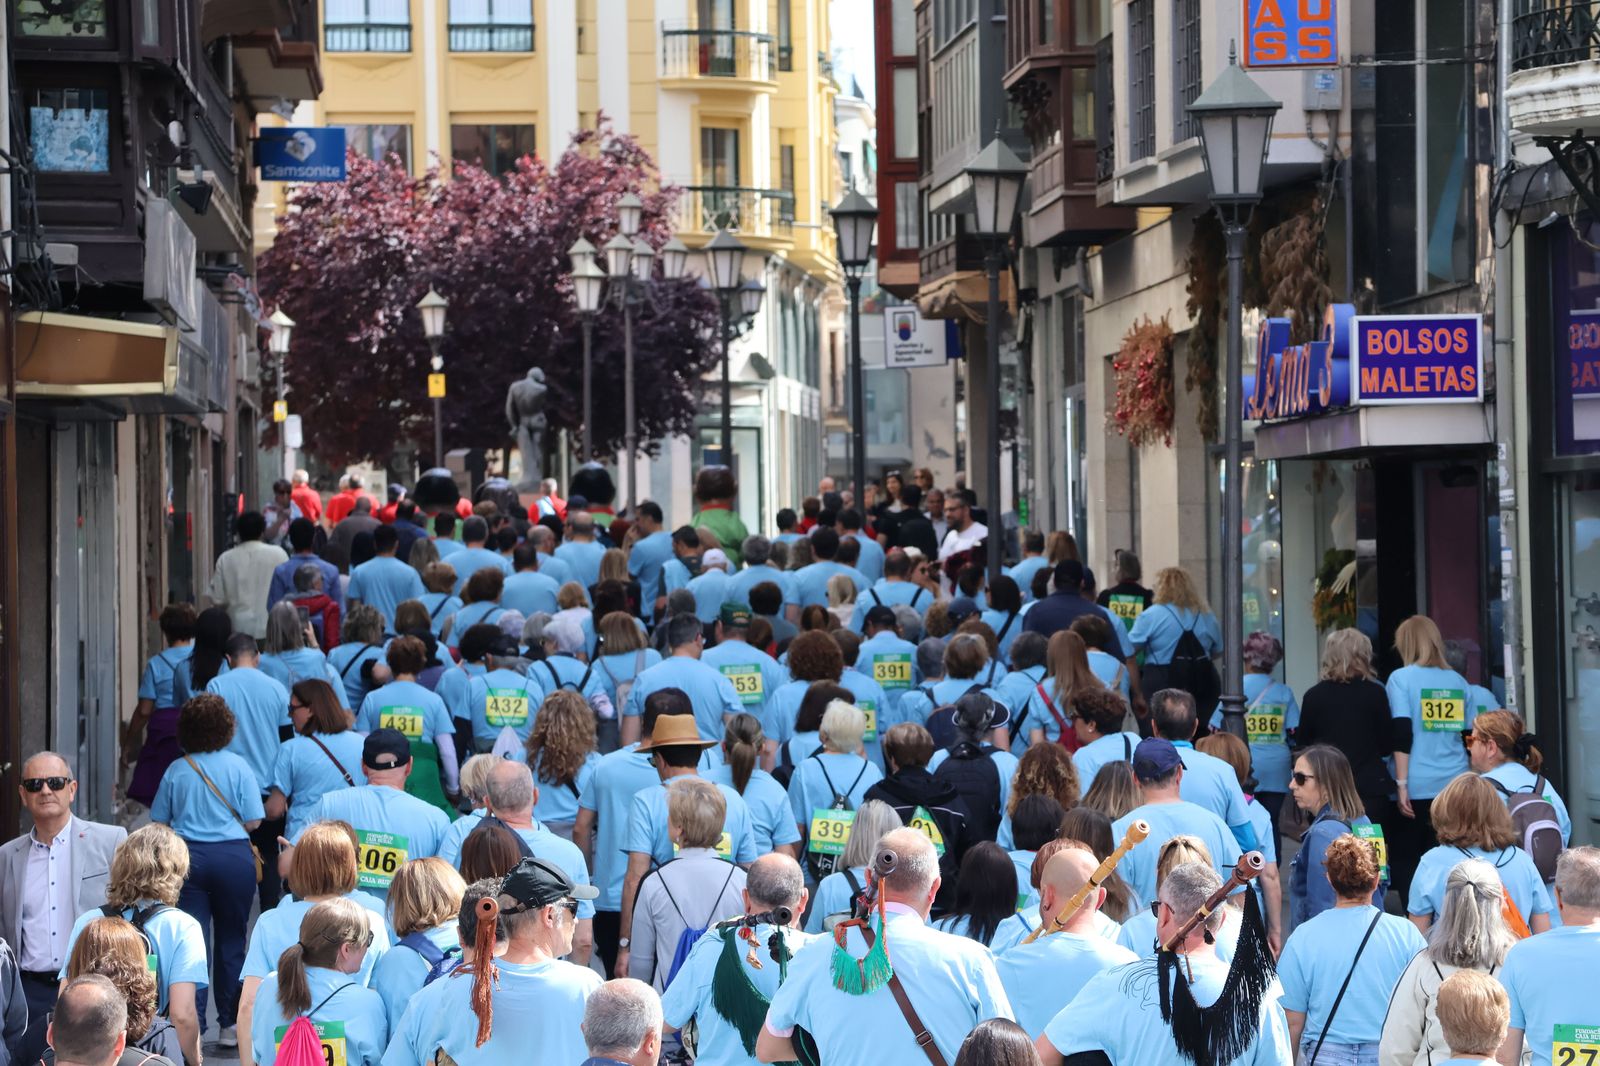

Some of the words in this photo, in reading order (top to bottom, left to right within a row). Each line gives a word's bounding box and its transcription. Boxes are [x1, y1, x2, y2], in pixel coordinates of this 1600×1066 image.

[265, 165, 340, 177] Samsonite
[1367, 327, 1469, 355] BOLSOS
[1361, 365, 1476, 393] MALETAS
[877, 664, 904, 679] 391
[490, 698, 522, 714] 432
[1425, 702, 1454, 719] 312
[385, 716, 416, 732] 431
[1247, 717, 1278, 732] 386
[818, 821, 851, 839] 39
[358, 848, 397, 873] 06
